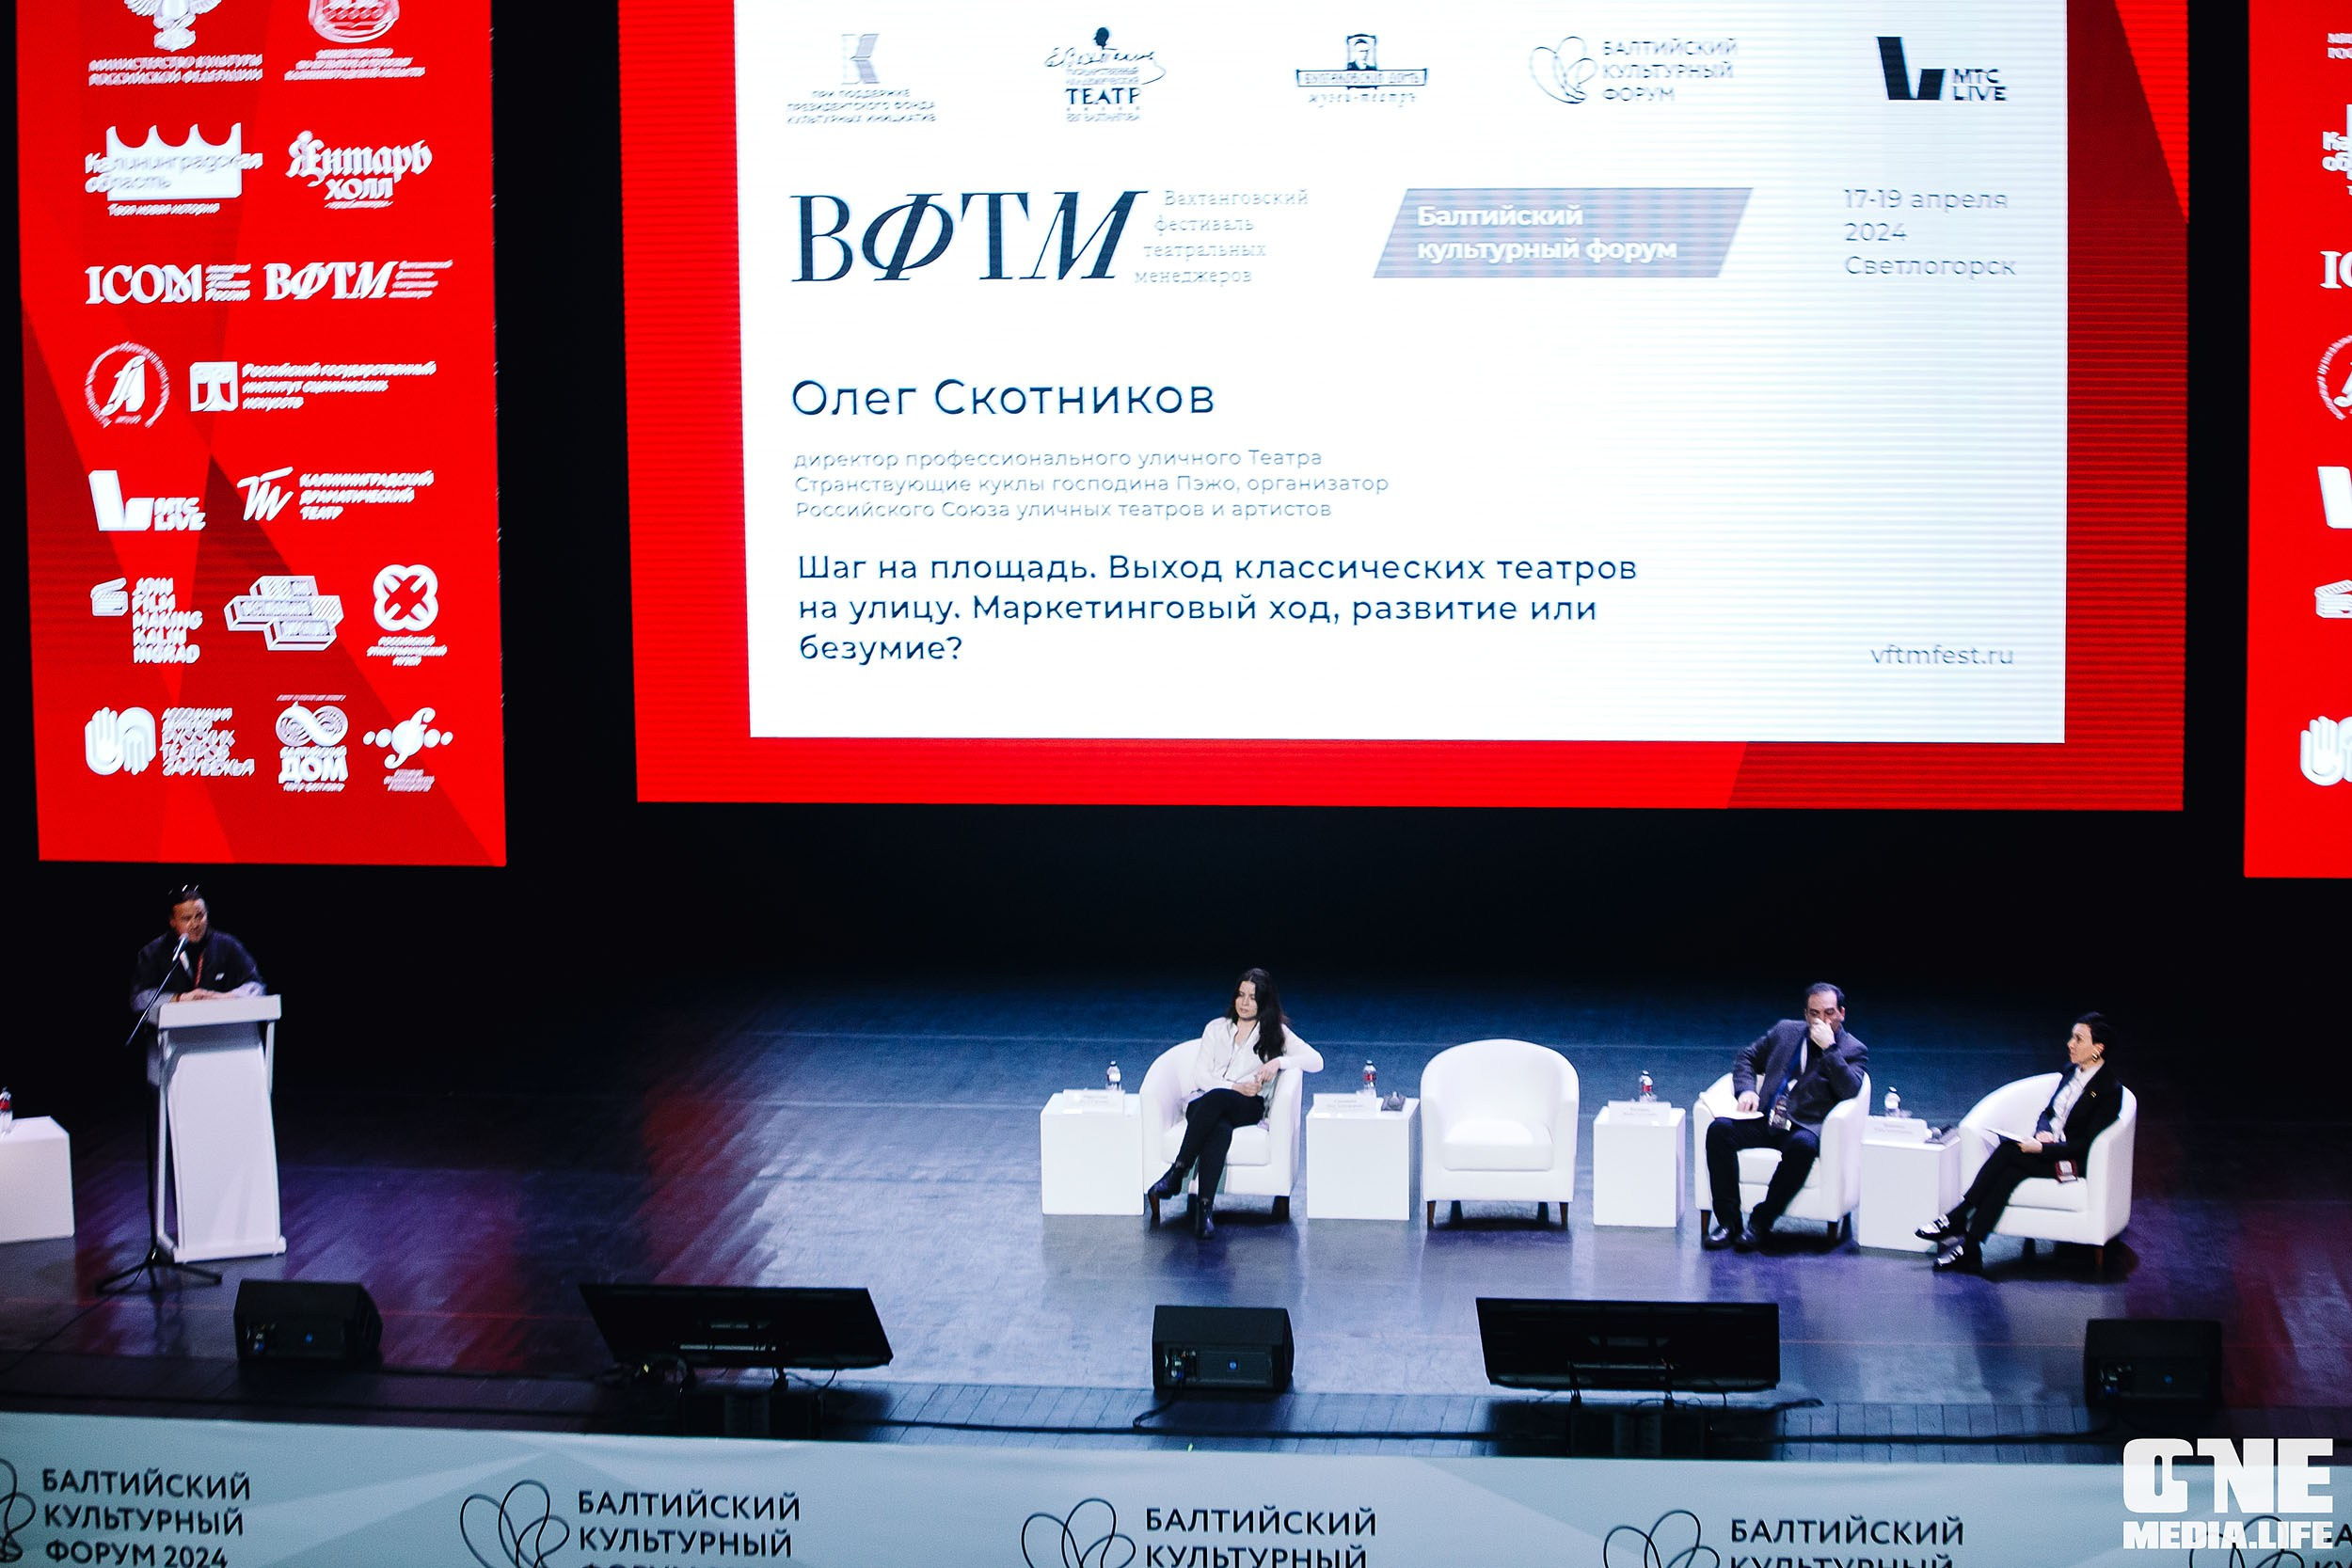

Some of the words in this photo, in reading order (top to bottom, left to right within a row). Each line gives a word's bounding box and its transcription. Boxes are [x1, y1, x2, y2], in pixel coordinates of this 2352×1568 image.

[1603, 38, 1739, 55] БАЛТИЙСКИЙ
[1602, 61, 1734, 78] КУЛЬТУРНЫЙ
[1065, 87, 1141, 104] ТЕАТР
[1602, 87, 1675, 102] ФОРУМ
[1952, 86, 2008, 101] LIVE
[285, 131, 433, 187] Янтарь
[85, 172, 172, 193] область
[1164, 189, 1310, 206] Вахтанговский
[1844, 189, 1901, 208] 17-19
[1911, 194, 2009, 214] апреля
[1154, 214, 1255, 236] фестиваль
[1417, 204, 1583, 227] Балтийский
[790, 191, 1149, 282] ВФТМ
[1844, 222, 1908, 241] 2024
[1143, 244, 1267, 262] театральных
[1417, 238, 1580, 264] культурный
[1585, 238, 1677, 264] форум
[1135, 269, 1252, 287] менеджеров
[1845, 255, 2017, 280] Светлогорск
[85, 264, 202, 304] ICOM
[263, 261, 399, 300] ВФТМ
[793, 378, 917, 415] Олег
[935, 378, 1215, 415] Скотников
[794, 452, 898, 470] директор
[906, 450, 1130, 470] профессионального
[1138, 452, 1241, 468] уличного
[1248, 450, 1322, 468] Театра
[795, 477, 971, 495] Странствующие
[979, 479, 1044, 492] куклы
[1053, 478, 1168, 494] господина
[1177, 476, 1241, 494] Пэжо,
[1248, 478, 1389, 495] организатор
[154, 513, 206, 531] LIVE
[796, 501, 934, 518] Российского
[942, 500, 1009, 517] Союза
[1017, 504, 1111, 520] уличных
[1119, 503, 1204, 519] театров
[1212, 505, 1224, 517] и
[1232, 503, 1332, 520] артистов
[799, 555, 866, 579] Шаг
[879, 562, 917, 579] на
[931, 561, 1097, 582] площадь.
[1109, 555, 1223, 582] Выход
[1235, 560, 1486, 579] классических
[1497, 560, 1637, 586] театров
[800, 600, 837, 619] на
[850, 600, 961, 625] улицу.
[974, 594, 1256, 625] Маркетинговый
[1269, 600, 1340, 626] ход,
[1353, 600, 1518, 626] развитие
[1531, 600, 1597, 620] или
[800, 635, 963, 666] безумие?
[1869, 644, 2014, 664] vftmfest.ru
[278, 756, 348, 784] ДОМ
[42, 1467, 250, 1501] БАЛТИЙСКИЙ
[578, 1488, 801, 1521] БАЛТИЙСКИЙ
[45, 1503, 244, 1537] КУЛЬТУРНЫЙ
[1146, 1505, 1375, 1536] БАЛТИЙСКИЙ
[1731, 1514, 1963, 1545] БАЛТИЙСКИЙ
[46, 1538, 155, 1567] ФОРУМ
[164, 1544, 228, 1568] 2024
[580, 1527, 792, 1558] КУЛЬТУРНЫЙ
[1146, 1544, 1367, 1568] КУЛЬТУРНЫЙ
